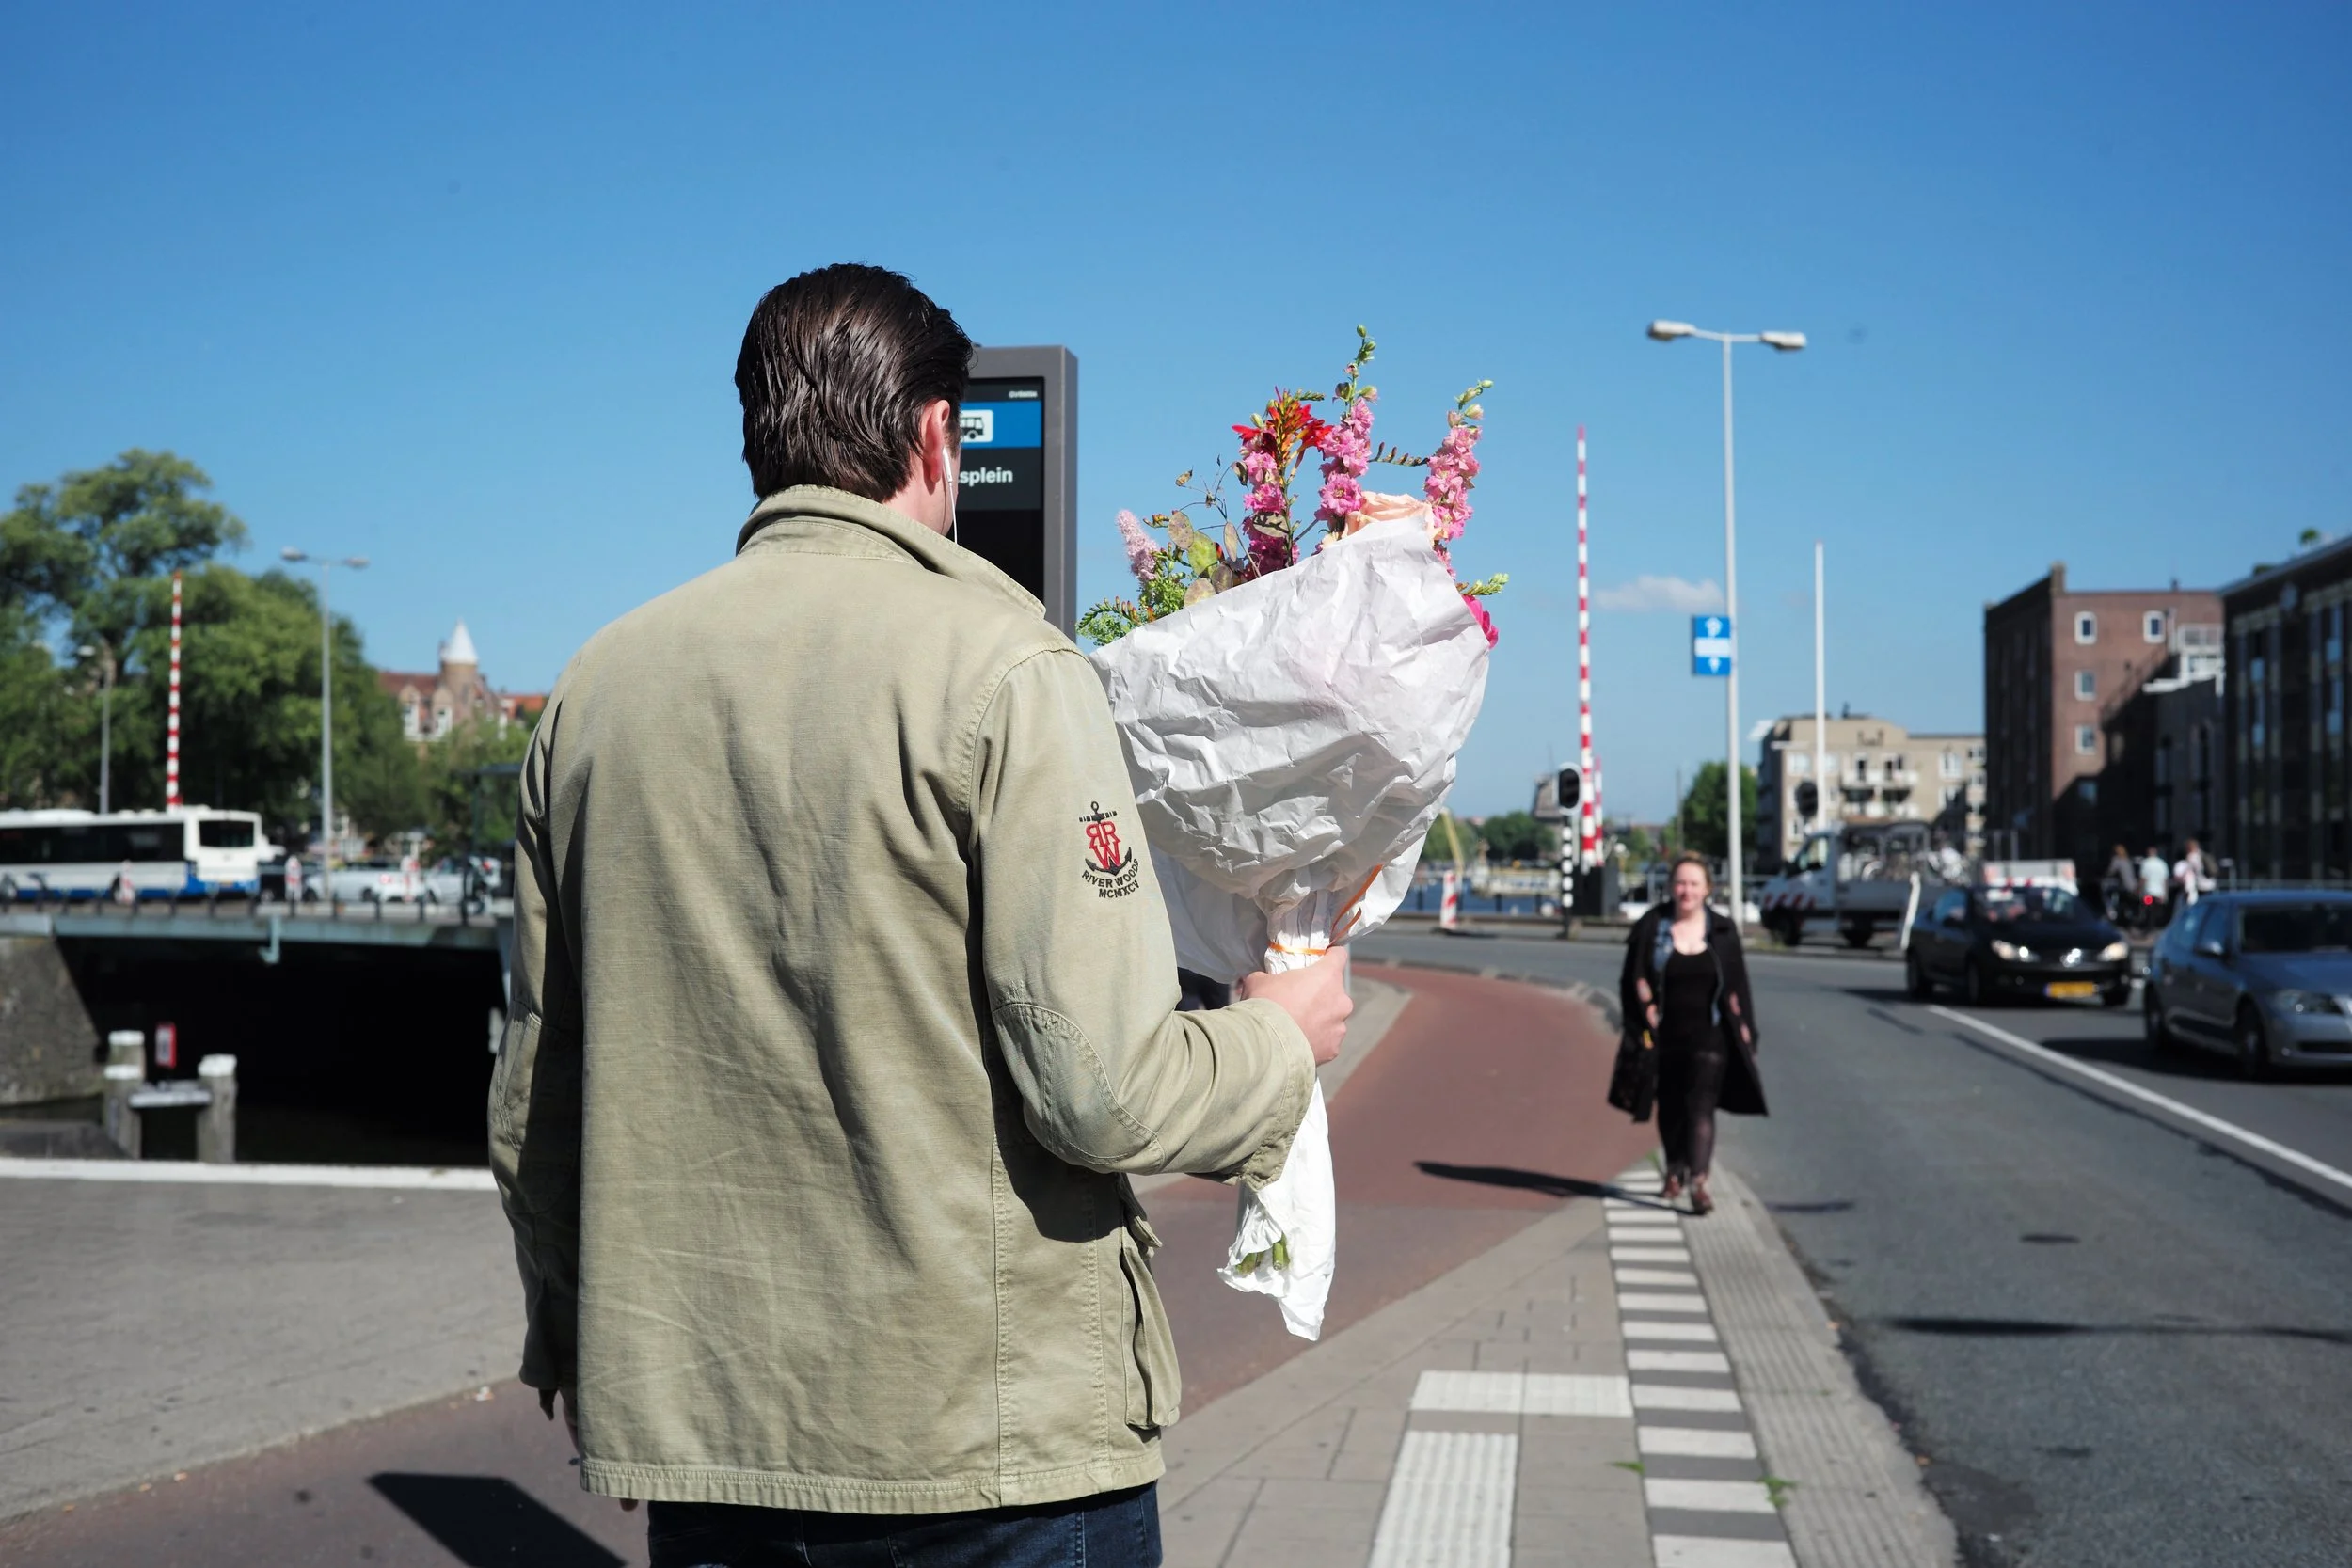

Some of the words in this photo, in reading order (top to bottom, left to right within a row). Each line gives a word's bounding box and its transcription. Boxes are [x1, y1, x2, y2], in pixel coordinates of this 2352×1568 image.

[958, 467, 1013, 487] splein
[1082, 870, 1113, 888] RIVER
[1115, 859, 1139, 887] WOODS
[1098, 879, 1140, 898] MCMXCV
